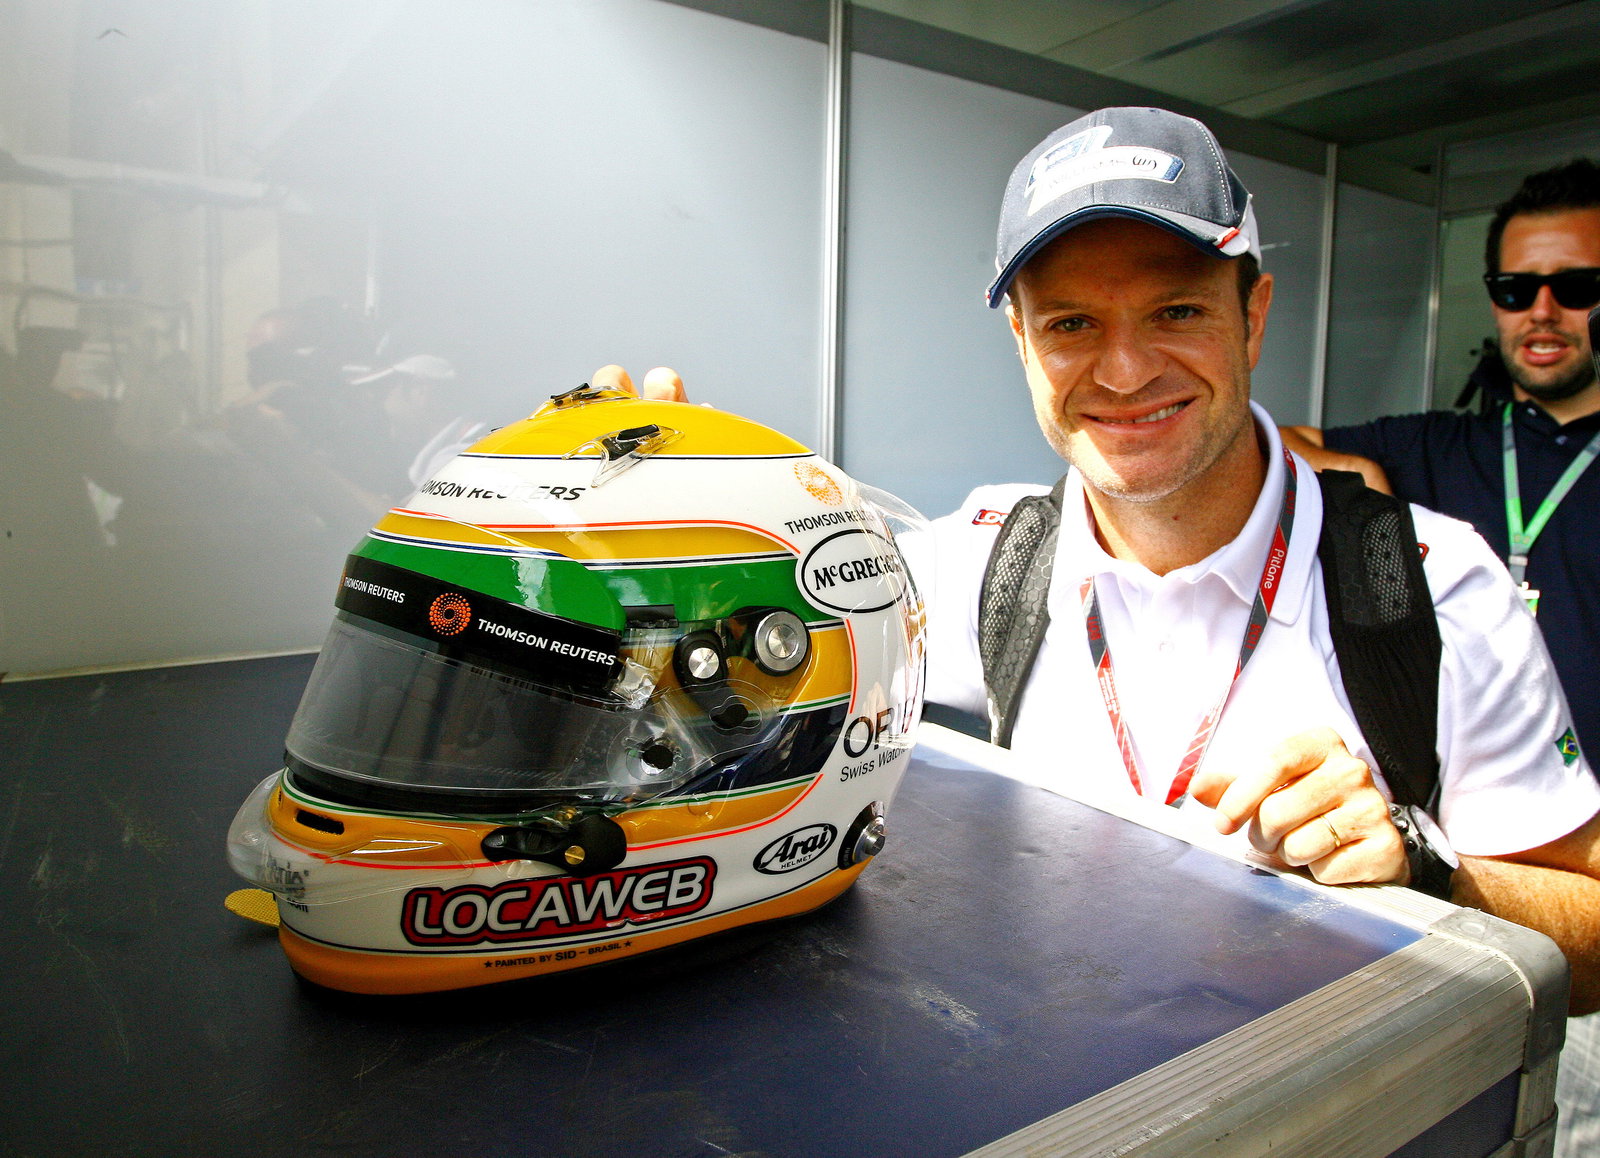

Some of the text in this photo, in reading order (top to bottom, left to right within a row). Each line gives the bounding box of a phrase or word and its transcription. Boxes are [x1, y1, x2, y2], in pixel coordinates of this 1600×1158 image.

[421, 479, 587, 501] OMSON REERS
[785, 512, 846, 534] THOMSON
[1264, 547, 1285, 589] Pitlane
[344, 576, 405, 604] THOMSON REUTERS
[478, 618, 617, 666] THOMSON REUTERS
[840, 762, 875, 782] Swiss
[759, 825, 830, 869] Arai
[781, 853, 813, 869] HELMET
[414, 865, 706, 936] LOCAWEB
[495, 957, 536, 967] PAINTED
[539, 954, 553, 963] BY
[555, 950, 577, 961] SID
[588, 943, 622, 955] BRASIL
